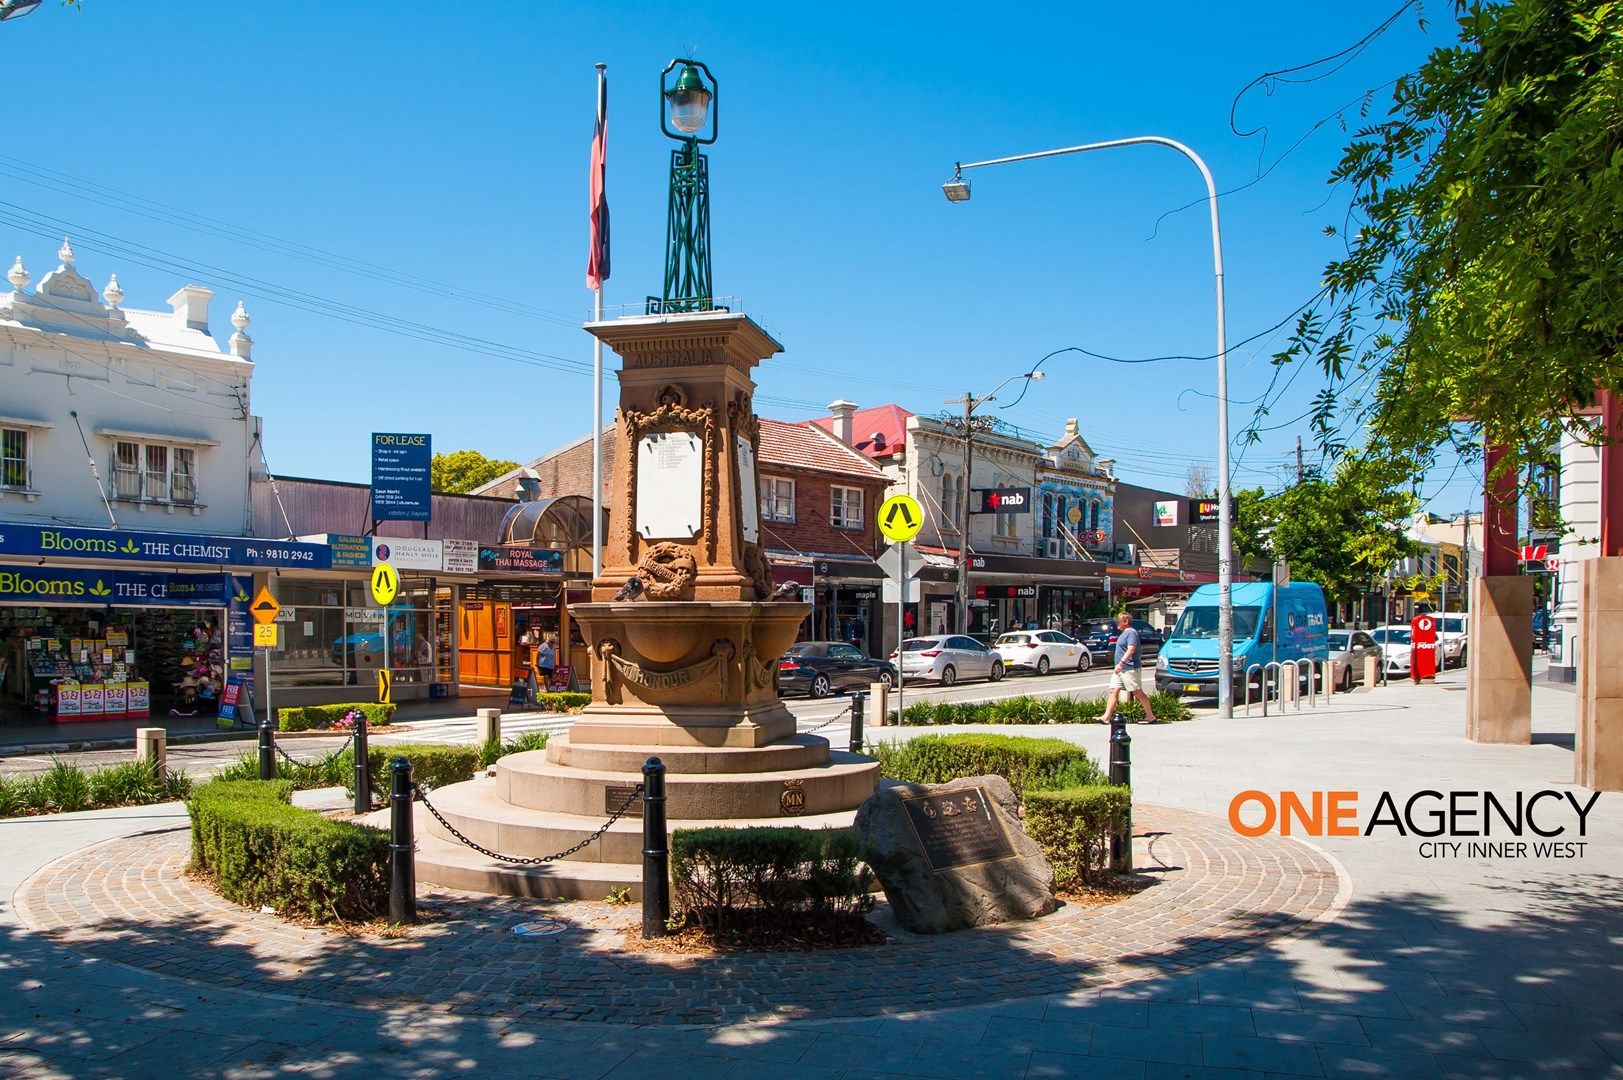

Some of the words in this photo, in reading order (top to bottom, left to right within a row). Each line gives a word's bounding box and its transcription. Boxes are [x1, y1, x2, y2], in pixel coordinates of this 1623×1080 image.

[633, 350, 713, 368] AUSTRALIA
[375, 435, 395, 445] FOR
[396, 436, 426, 446] LEASE
[1001, 492, 1024, 505] nab
[41, 531, 117, 553] Blooms
[142, 542, 170, 556] THE
[173, 543, 231, 559] CHEMIST
[396, 545, 435, 553] DOUGLASS
[246, 548, 258, 558] Ph
[266, 549, 289, 560] 9810
[291, 551, 314, 561] 2942
[509, 550, 534, 559] ROYAL
[494, 558, 512, 567] THAI
[513, 559, 548, 568] MASSAGE
[973, 557, 986, 568] nab
[0, 573, 85, 596] Blooms
[116, 582, 148, 597] THE
[855, 591, 876, 600] maple
[1018, 586, 1035, 596] nab
[259, 626, 273, 638] 25
[227, 684, 239, 694] FREE
[786, 793, 803, 806] MN
